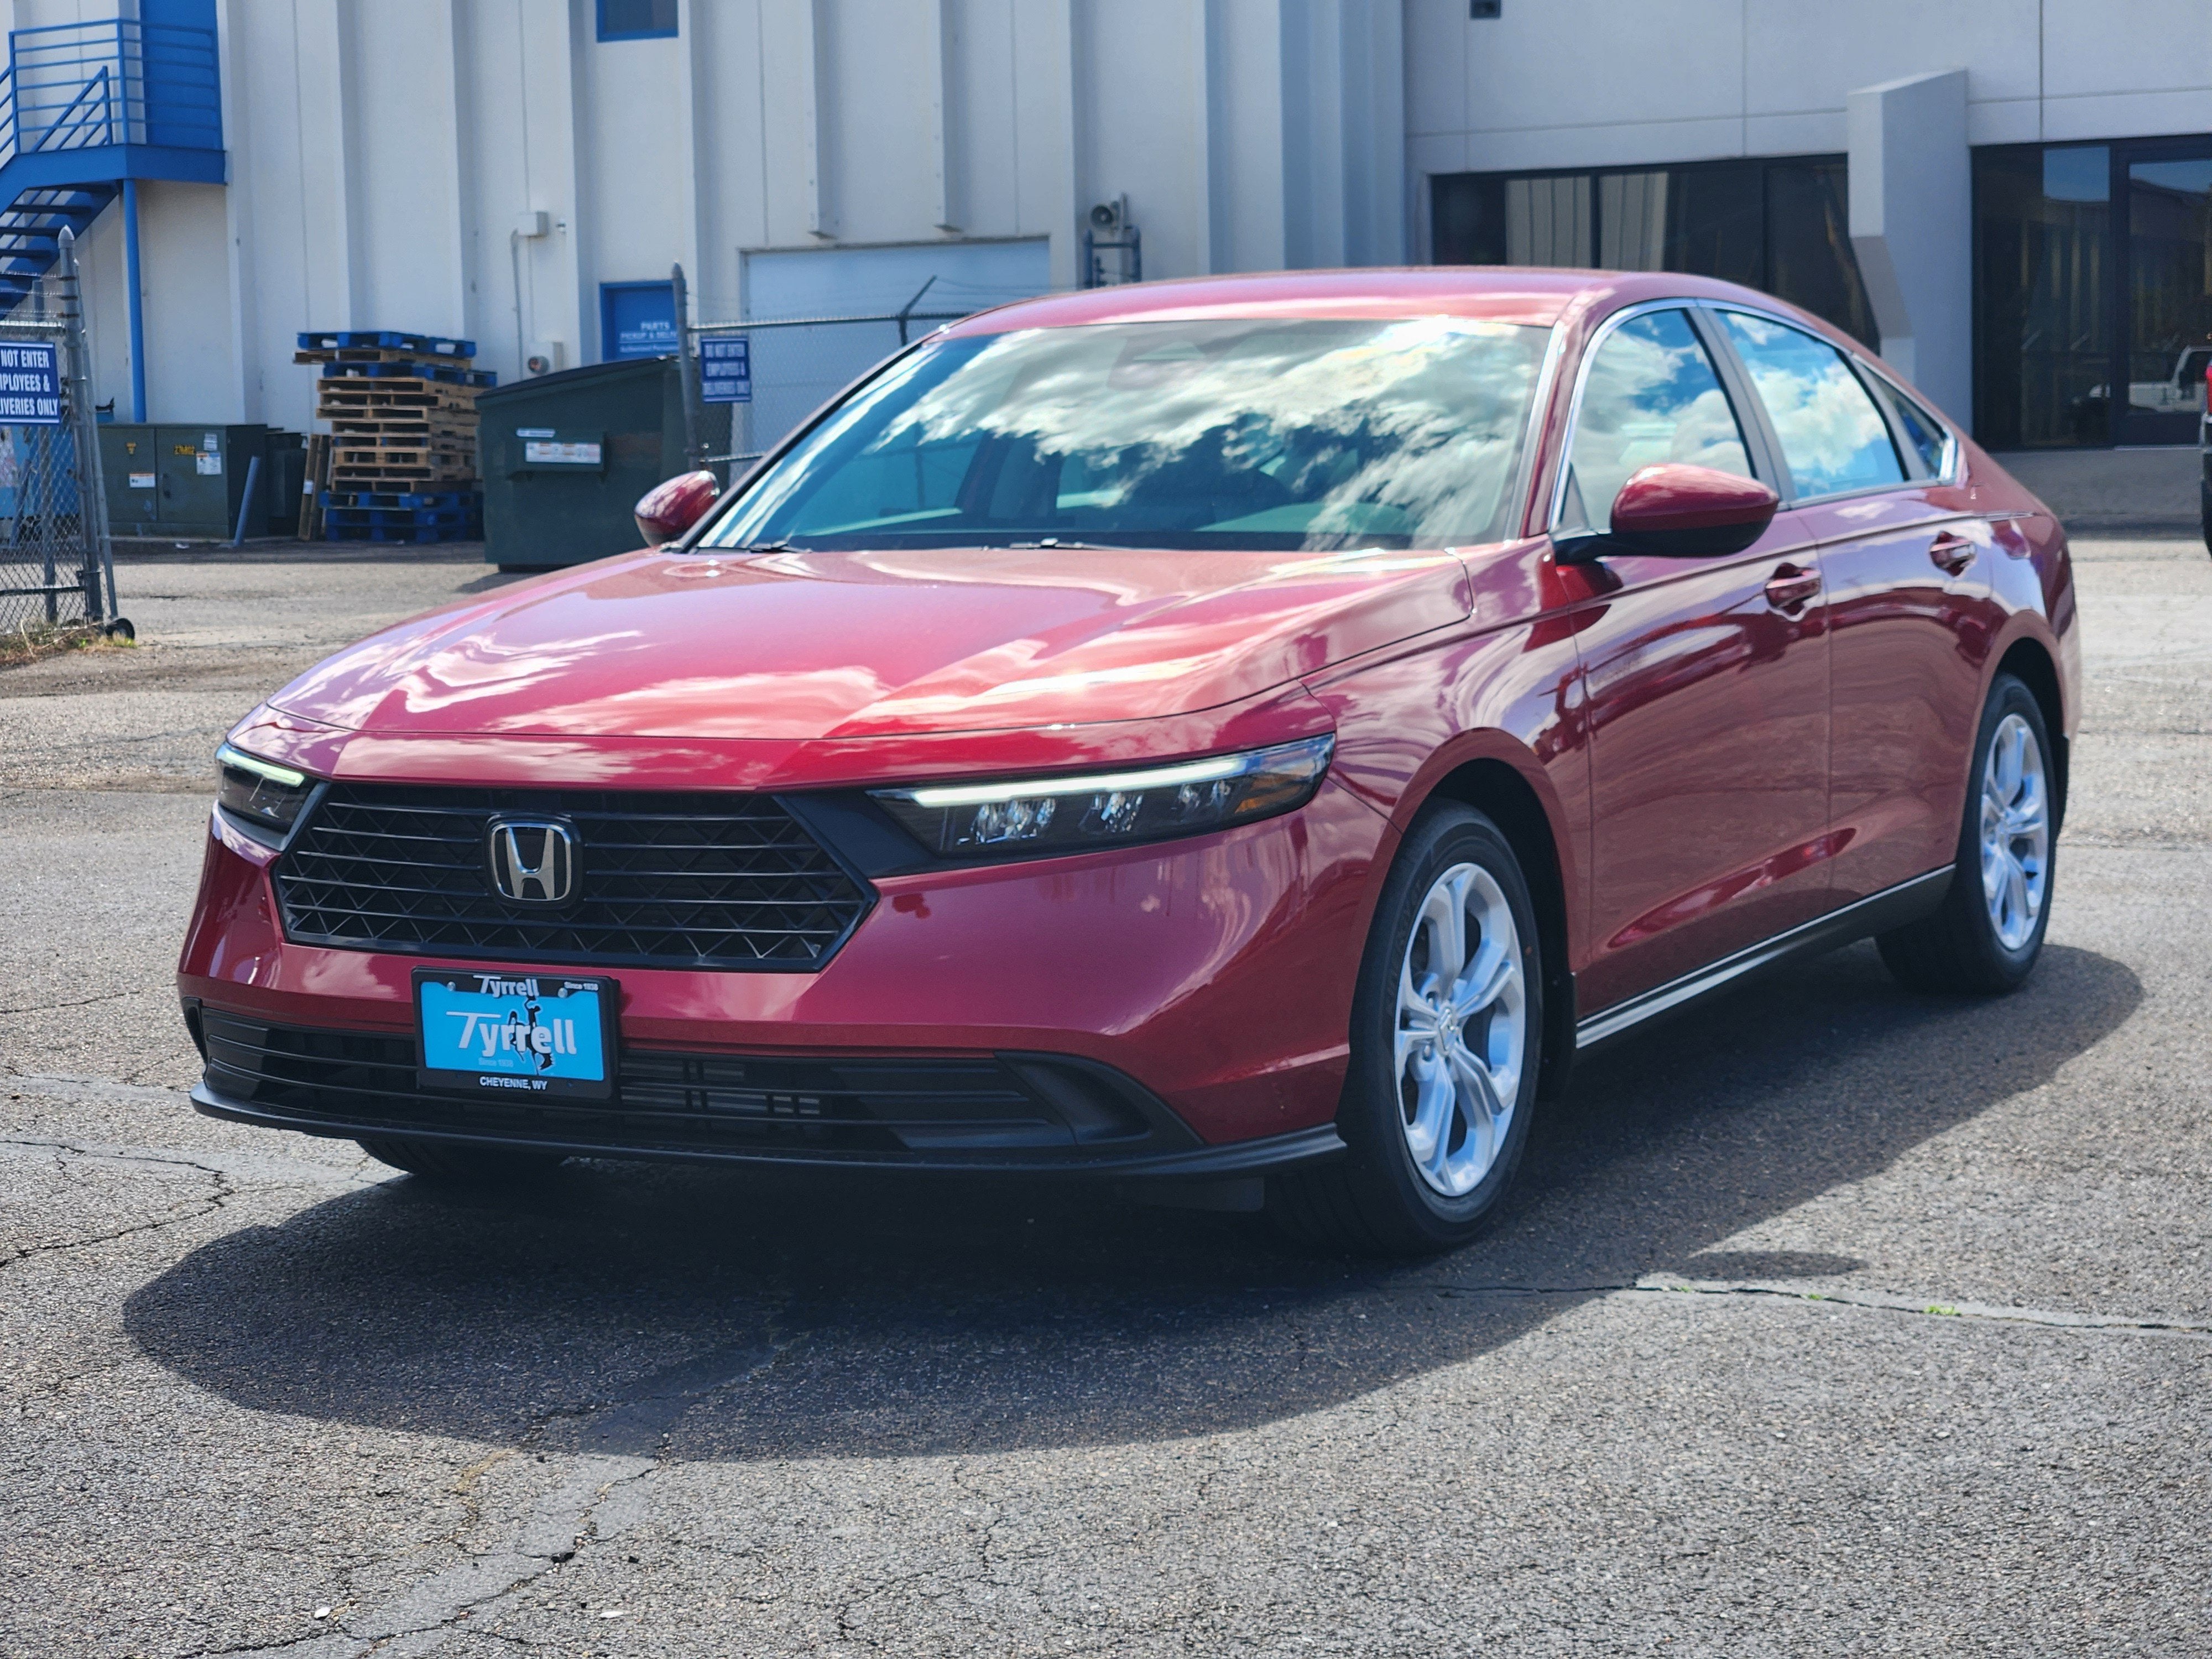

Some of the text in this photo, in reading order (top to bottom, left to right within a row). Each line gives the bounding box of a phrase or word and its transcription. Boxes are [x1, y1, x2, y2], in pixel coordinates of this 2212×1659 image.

[1, 349, 49, 368] NOT ENTER
[43, 374, 50, 392] &
[37, 398, 58, 416] ONLY
[473, 975, 540, 998] Tyrrell
[446, 1011, 577, 1057] Tyrrell
[479, 1076, 547, 1091] CHEYENNE, WY
